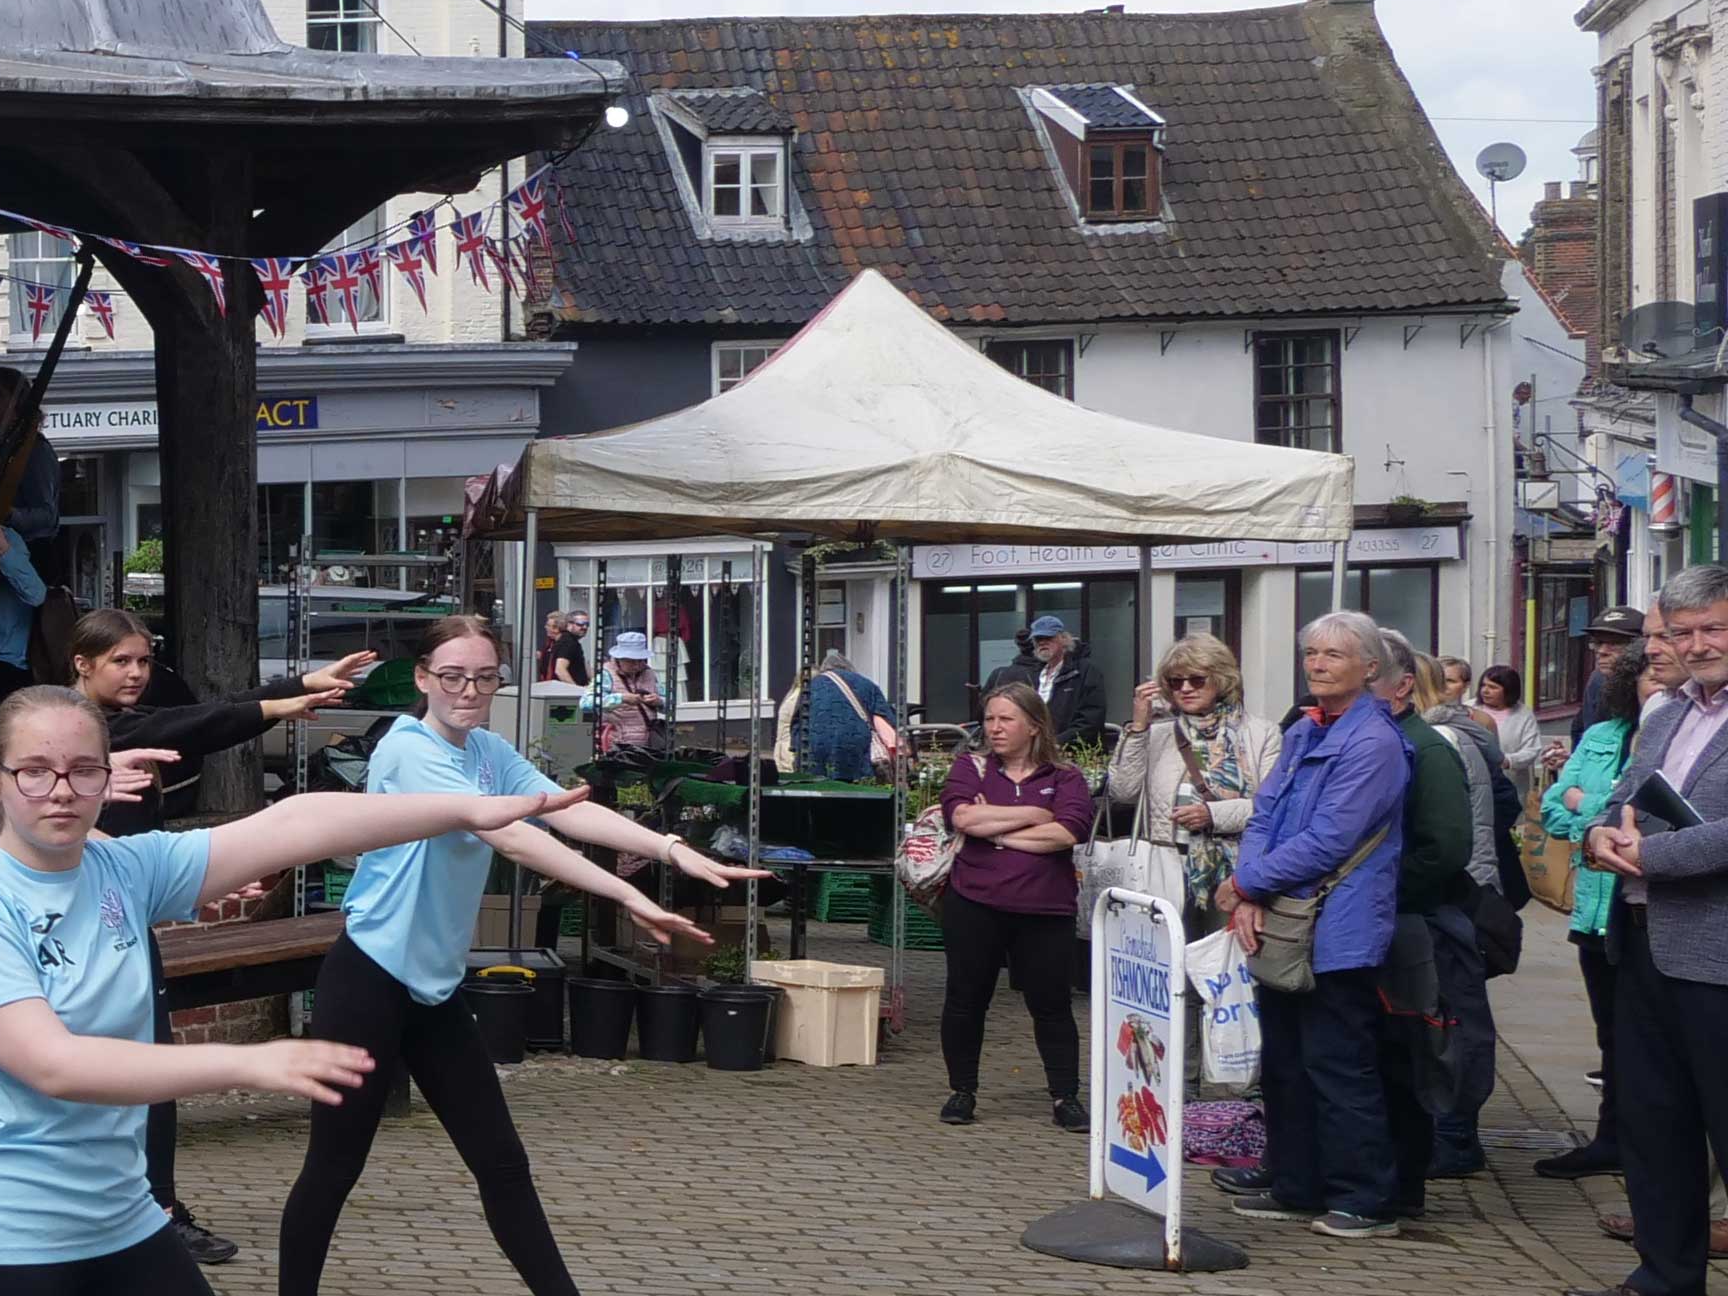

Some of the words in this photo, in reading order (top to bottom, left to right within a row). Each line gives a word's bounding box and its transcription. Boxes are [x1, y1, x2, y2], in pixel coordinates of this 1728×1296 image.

[255, 400, 309, 428] ACT
[1127, 544, 1179, 558] Lser
[1421, 534, 1440, 551] 27
[931, 552, 950, 569] 27
[1029, 546, 1094, 562] Health
[1111, 954, 1170, 1013] FISHMONGERS
